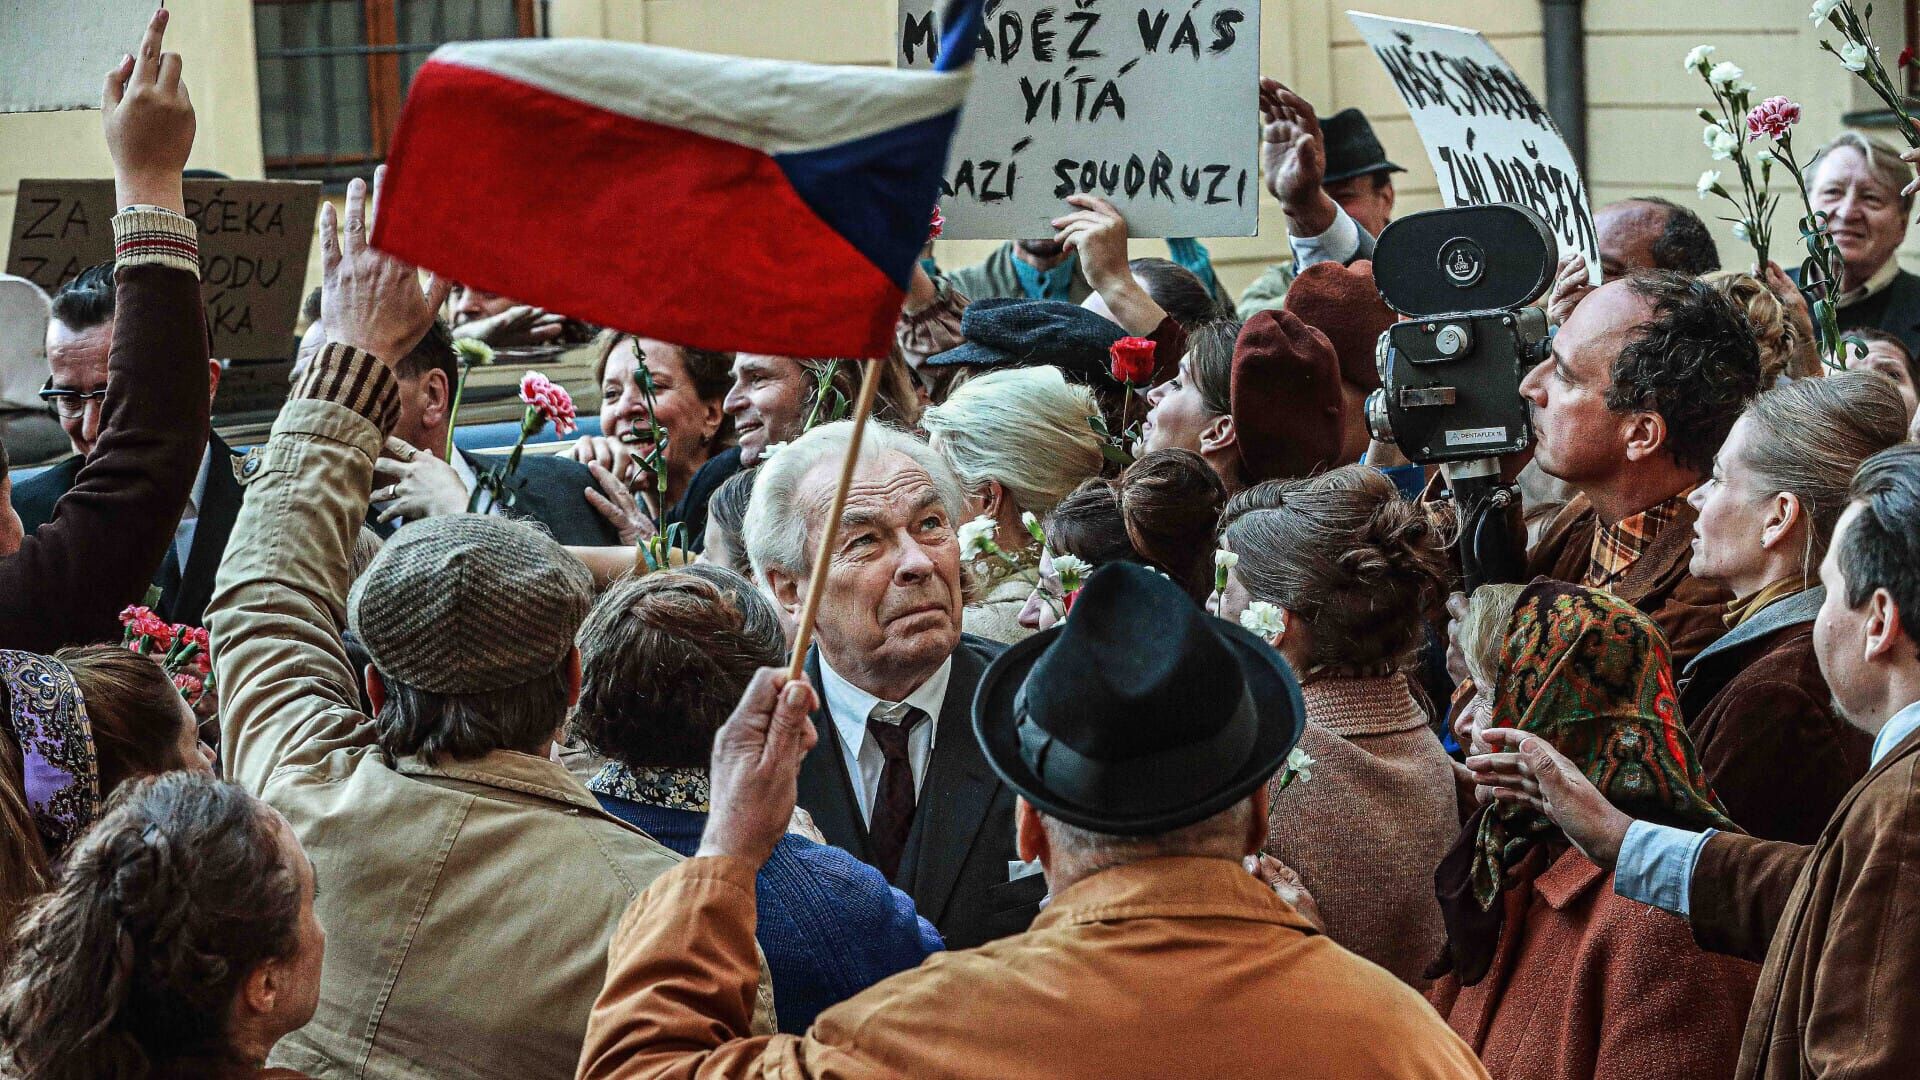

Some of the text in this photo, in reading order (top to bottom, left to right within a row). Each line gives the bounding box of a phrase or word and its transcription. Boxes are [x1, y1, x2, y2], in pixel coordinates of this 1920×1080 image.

[903, 0, 1245, 65] MÁDEŽ VÁS
[1053, 150, 1246, 207] SOUDRUZI
[21, 198, 90, 239] ZA
